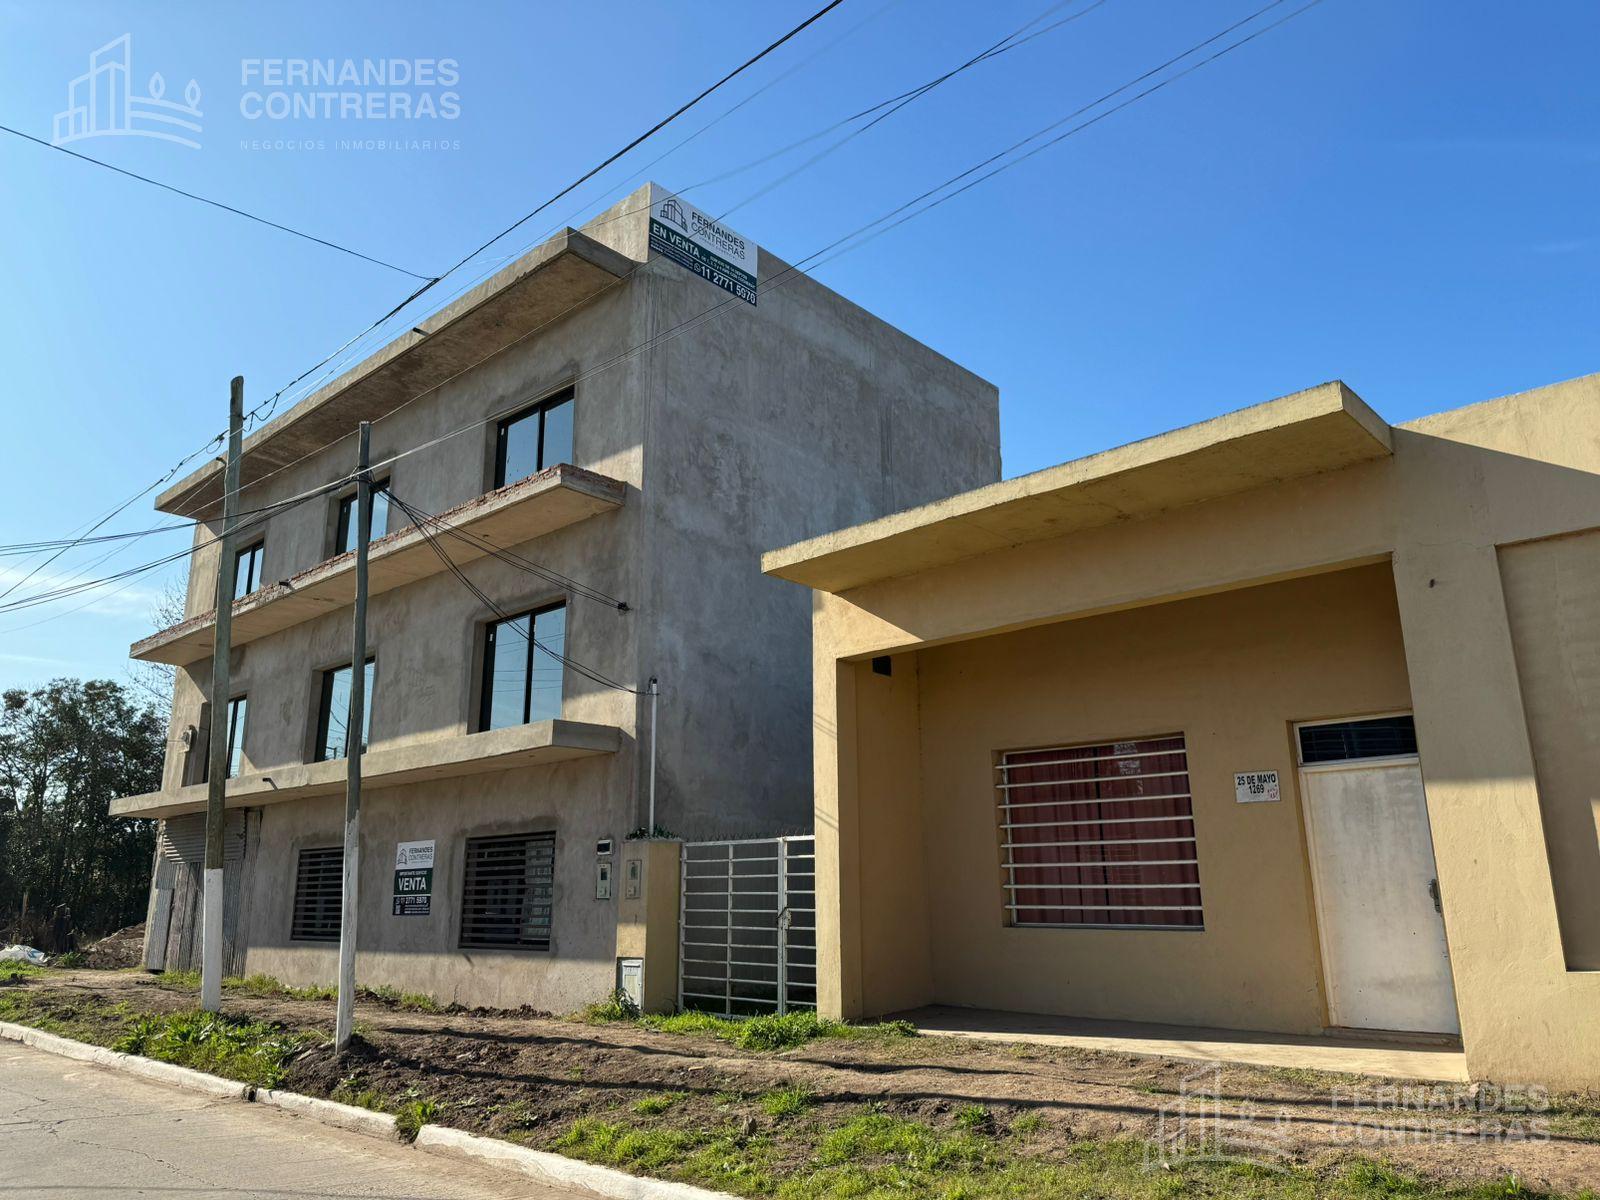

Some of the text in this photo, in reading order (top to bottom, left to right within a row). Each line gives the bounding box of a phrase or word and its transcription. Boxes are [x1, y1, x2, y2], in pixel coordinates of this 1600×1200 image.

[691, 211, 745, 250] FERNANDES
[653, 223, 667, 239] EN
[669, 231, 700, 259] VENTA
[691, 222, 746, 260] CONTRERAS
[701, 265, 711, 280] 11
[713, 272, 734, 292] 2771
[1237, 773, 1276, 785] 25 DE MAYO
[1249, 784, 1264, 794] 1269
[408, 846, 433, 854] FERNANDES
[398, 877, 426, 890] VENTA
